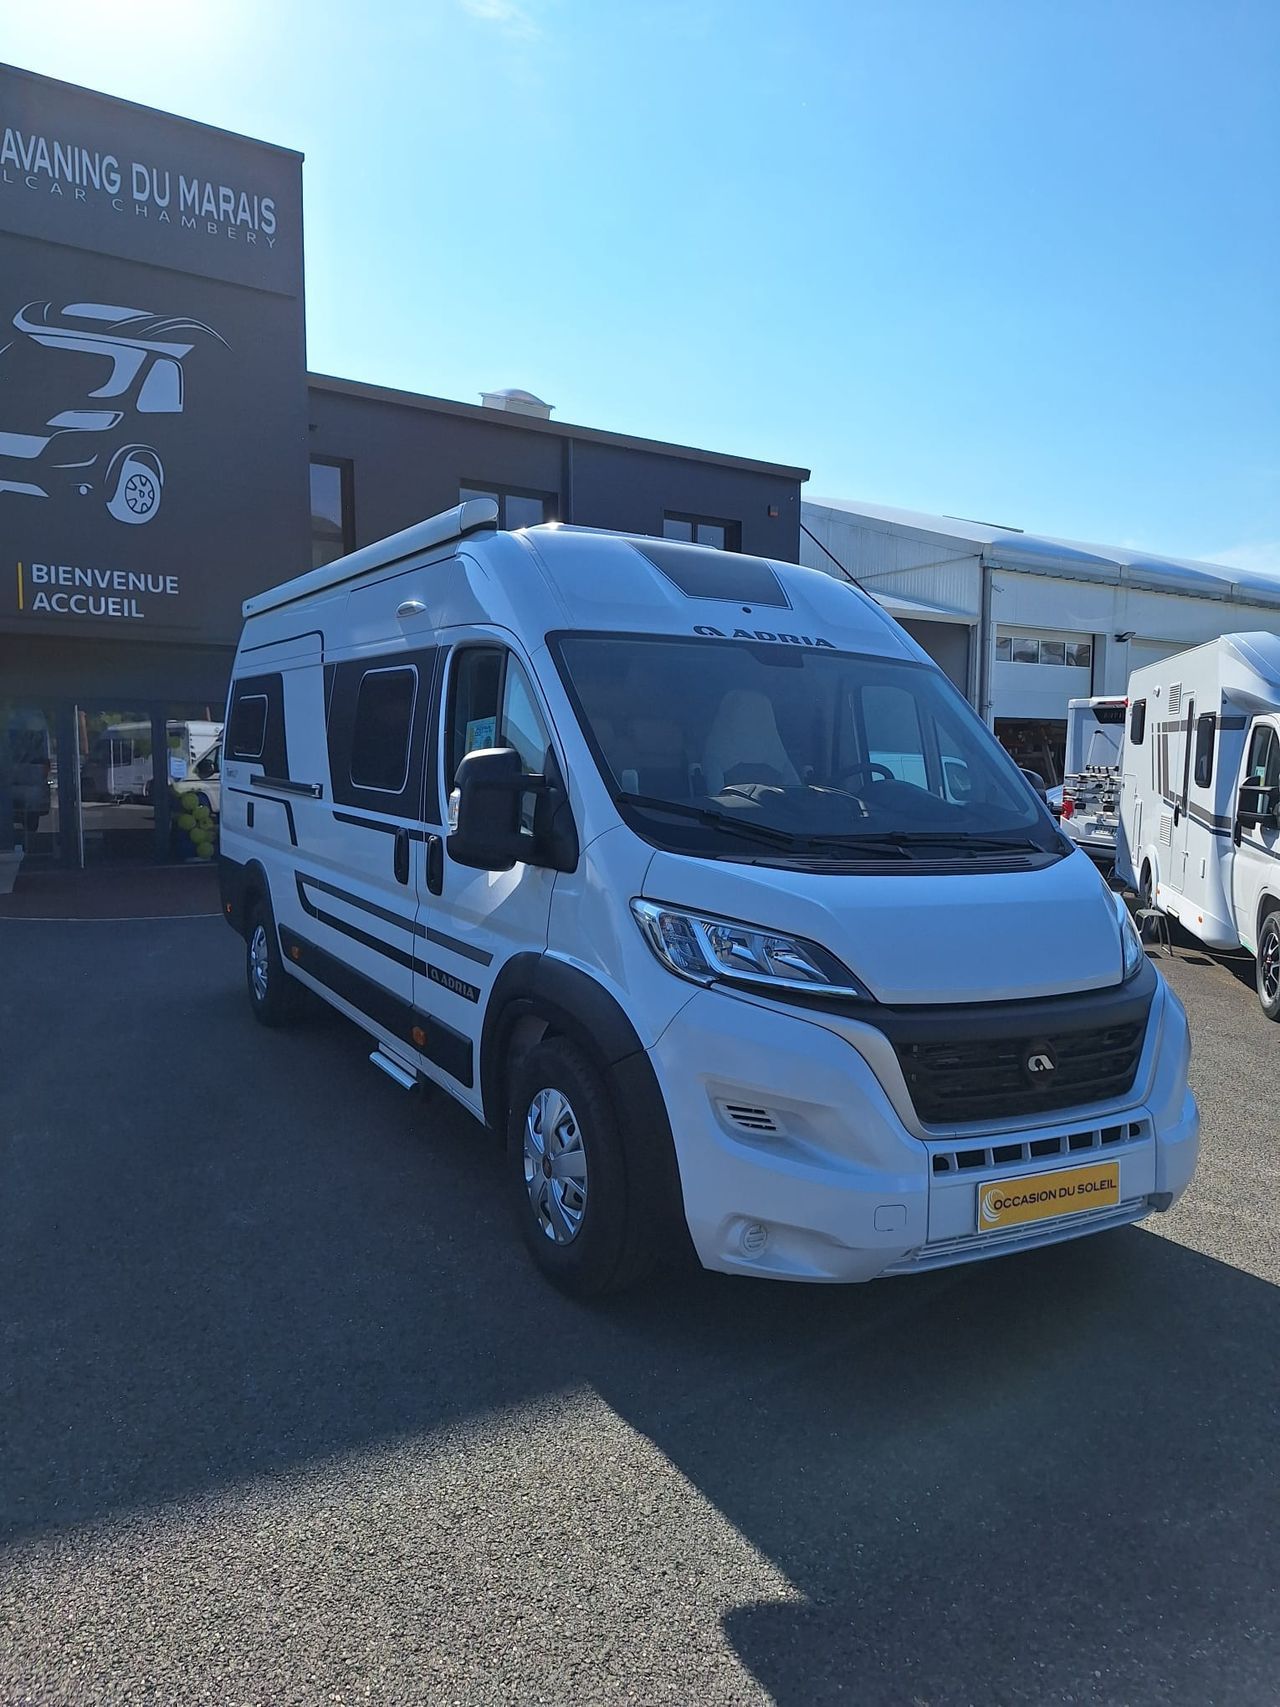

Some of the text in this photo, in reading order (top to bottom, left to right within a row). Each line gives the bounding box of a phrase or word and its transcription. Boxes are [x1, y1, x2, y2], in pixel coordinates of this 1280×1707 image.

[0, 127, 277, 235] AVANING DU MARAIS
[112, 198, 276, 248] CHAMBERY
[31, 563, 179, 594] BIENVENUE
[32, 592, 145, 618] ACCUEIL
[732, 628, 837, 649] ADRIA
[993, 1179, 1117, 1210] OCCASION DU SOLEIL
